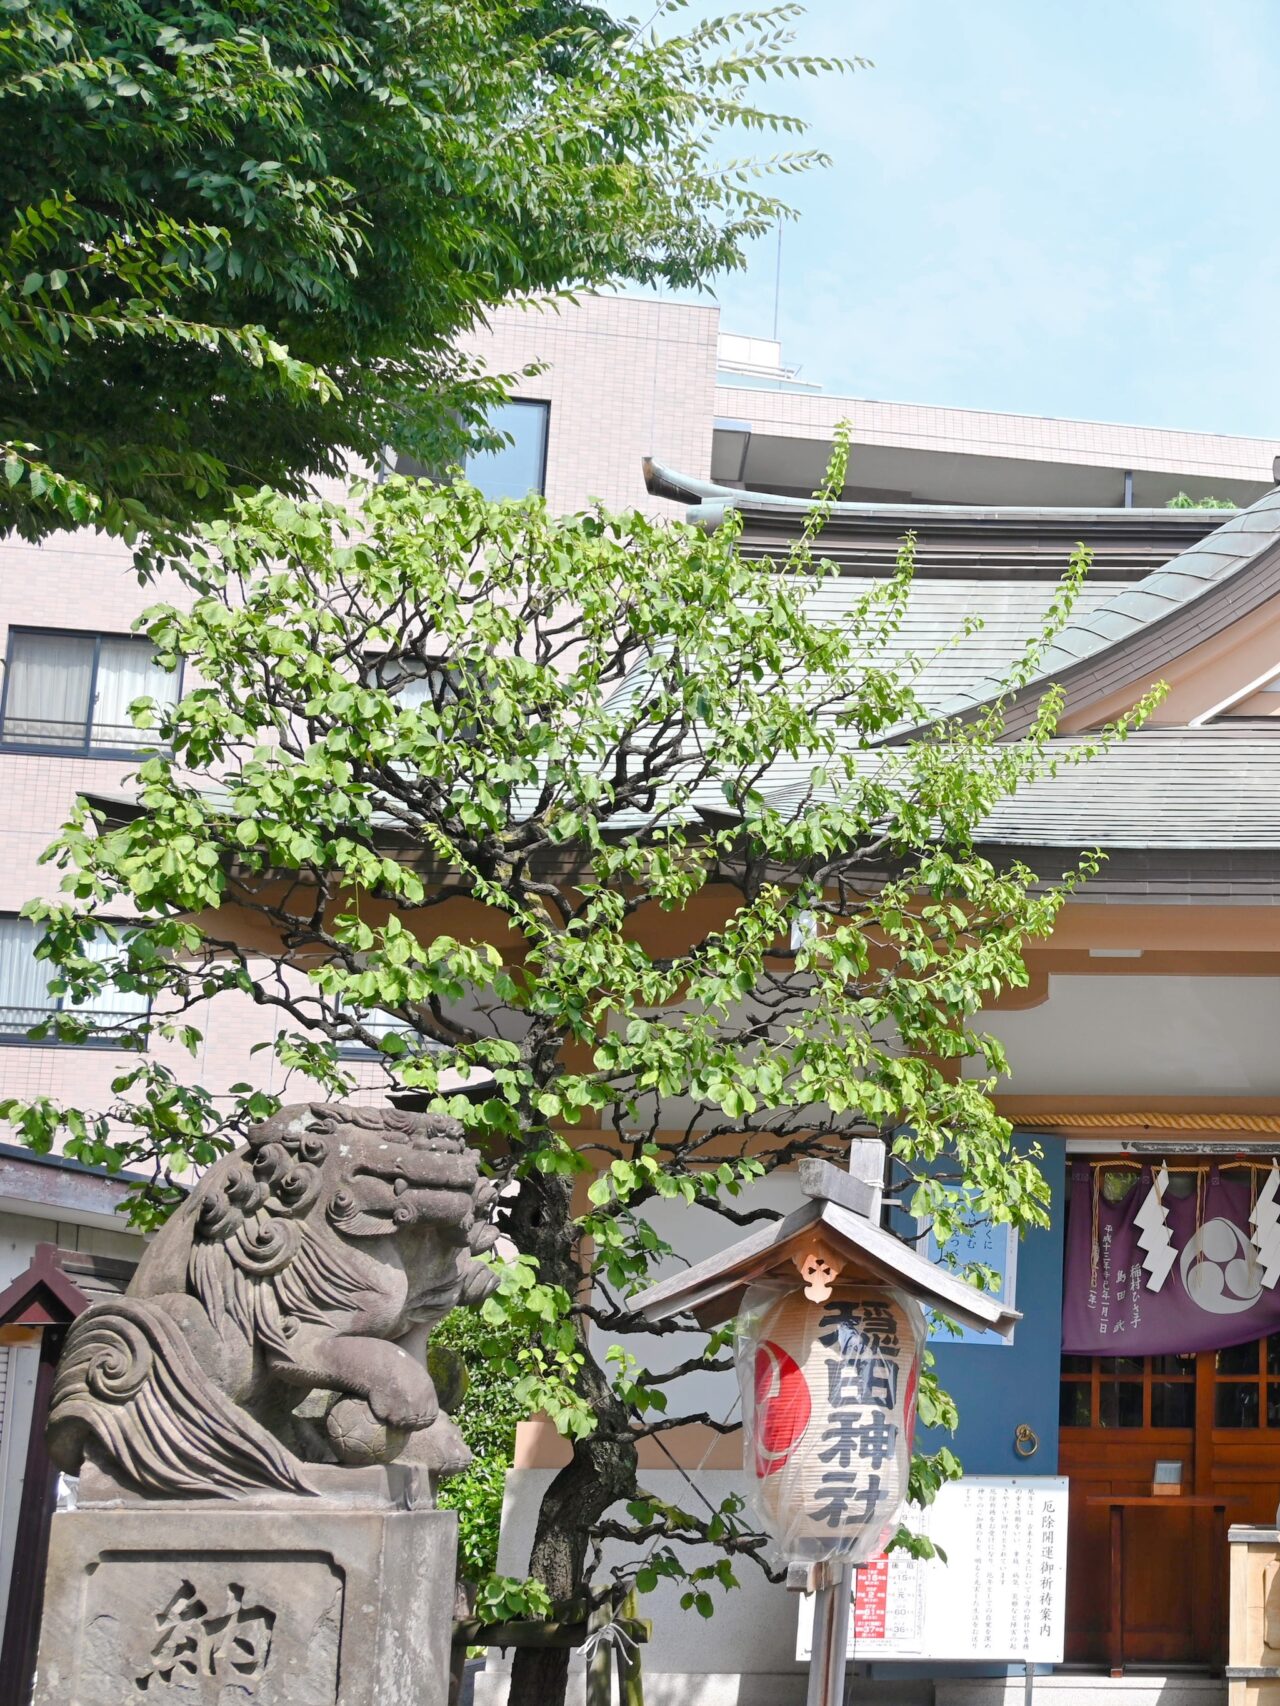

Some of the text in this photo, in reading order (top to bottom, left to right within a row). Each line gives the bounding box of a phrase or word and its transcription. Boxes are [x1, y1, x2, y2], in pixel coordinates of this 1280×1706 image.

[1039, 1499, 1056, 1637] 厄除開運御祈祷案内
[135, 1578, 277, 1692] 納
